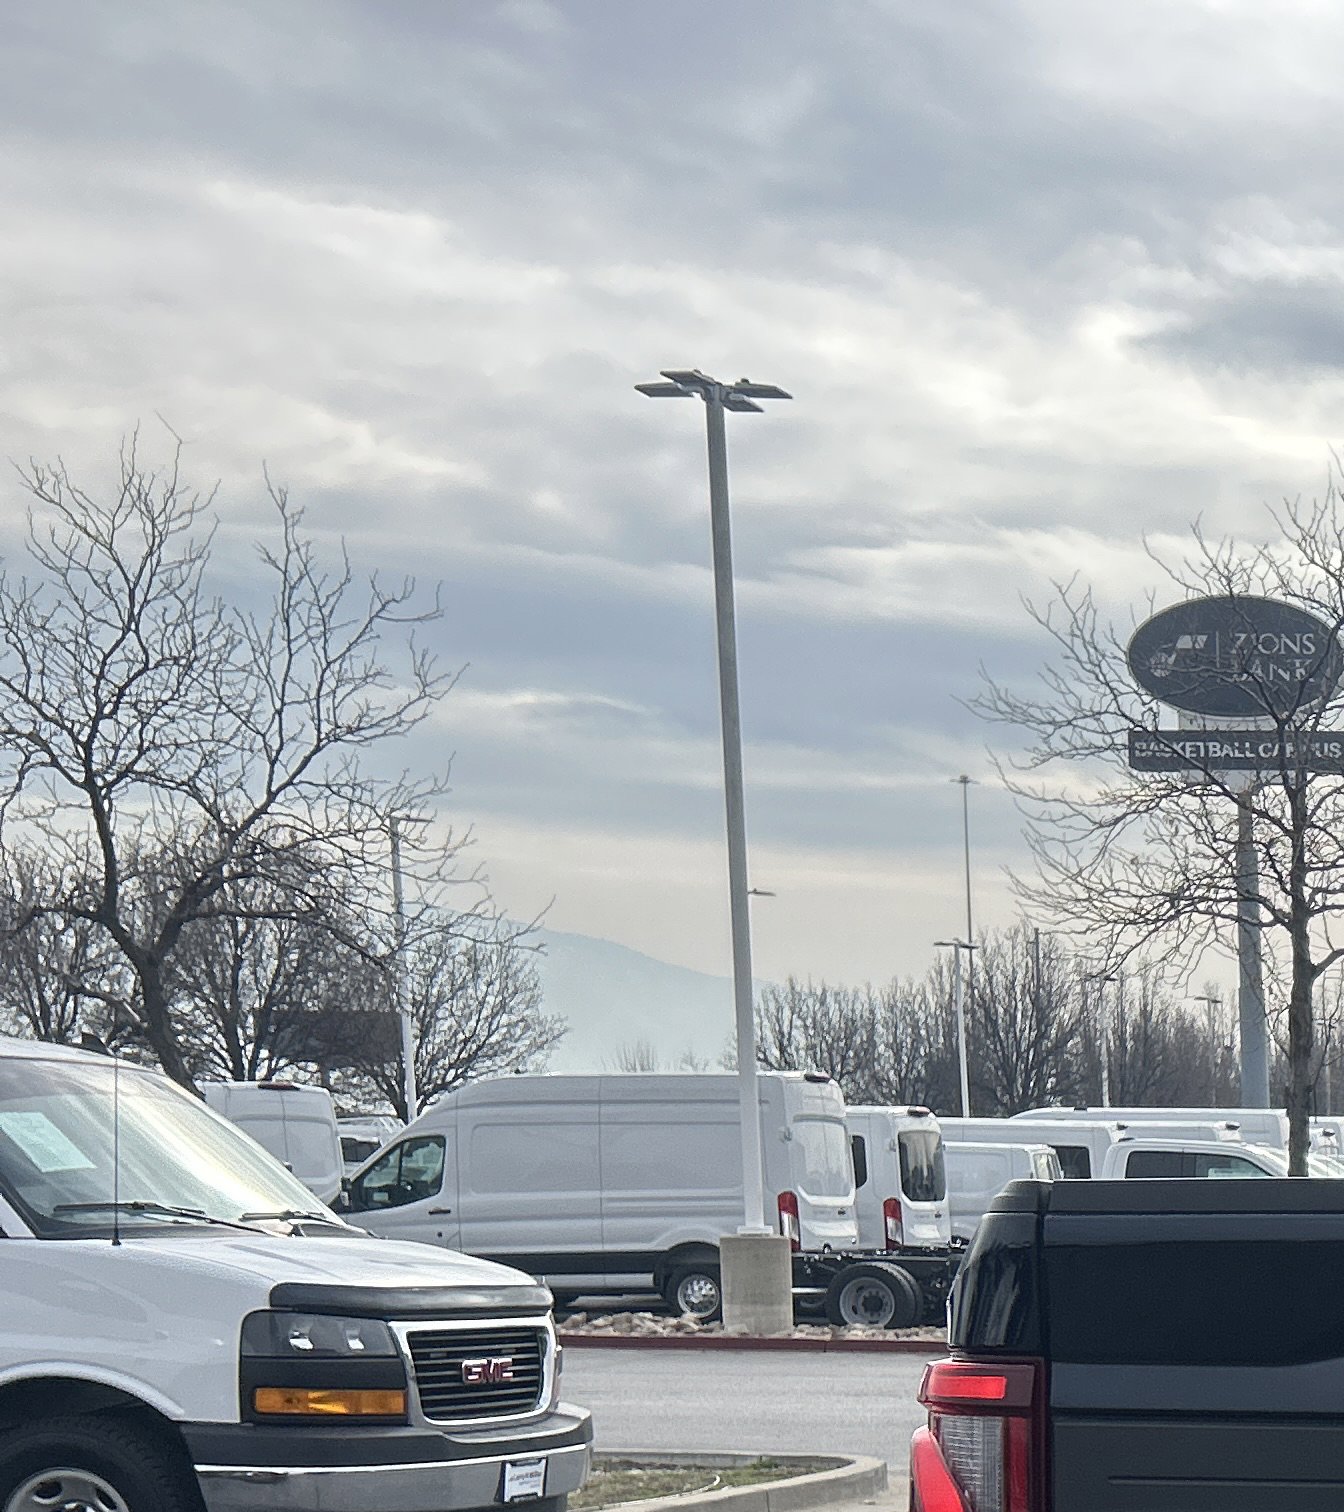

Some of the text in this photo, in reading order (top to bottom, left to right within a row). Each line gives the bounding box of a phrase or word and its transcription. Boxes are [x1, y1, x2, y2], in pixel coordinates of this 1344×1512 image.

[1230, 633, 1316, 655] ZIONS
[1134, 741, 1342, 759] BASKETBALL CUS
[462, 1358, 514, 1385] GMC
